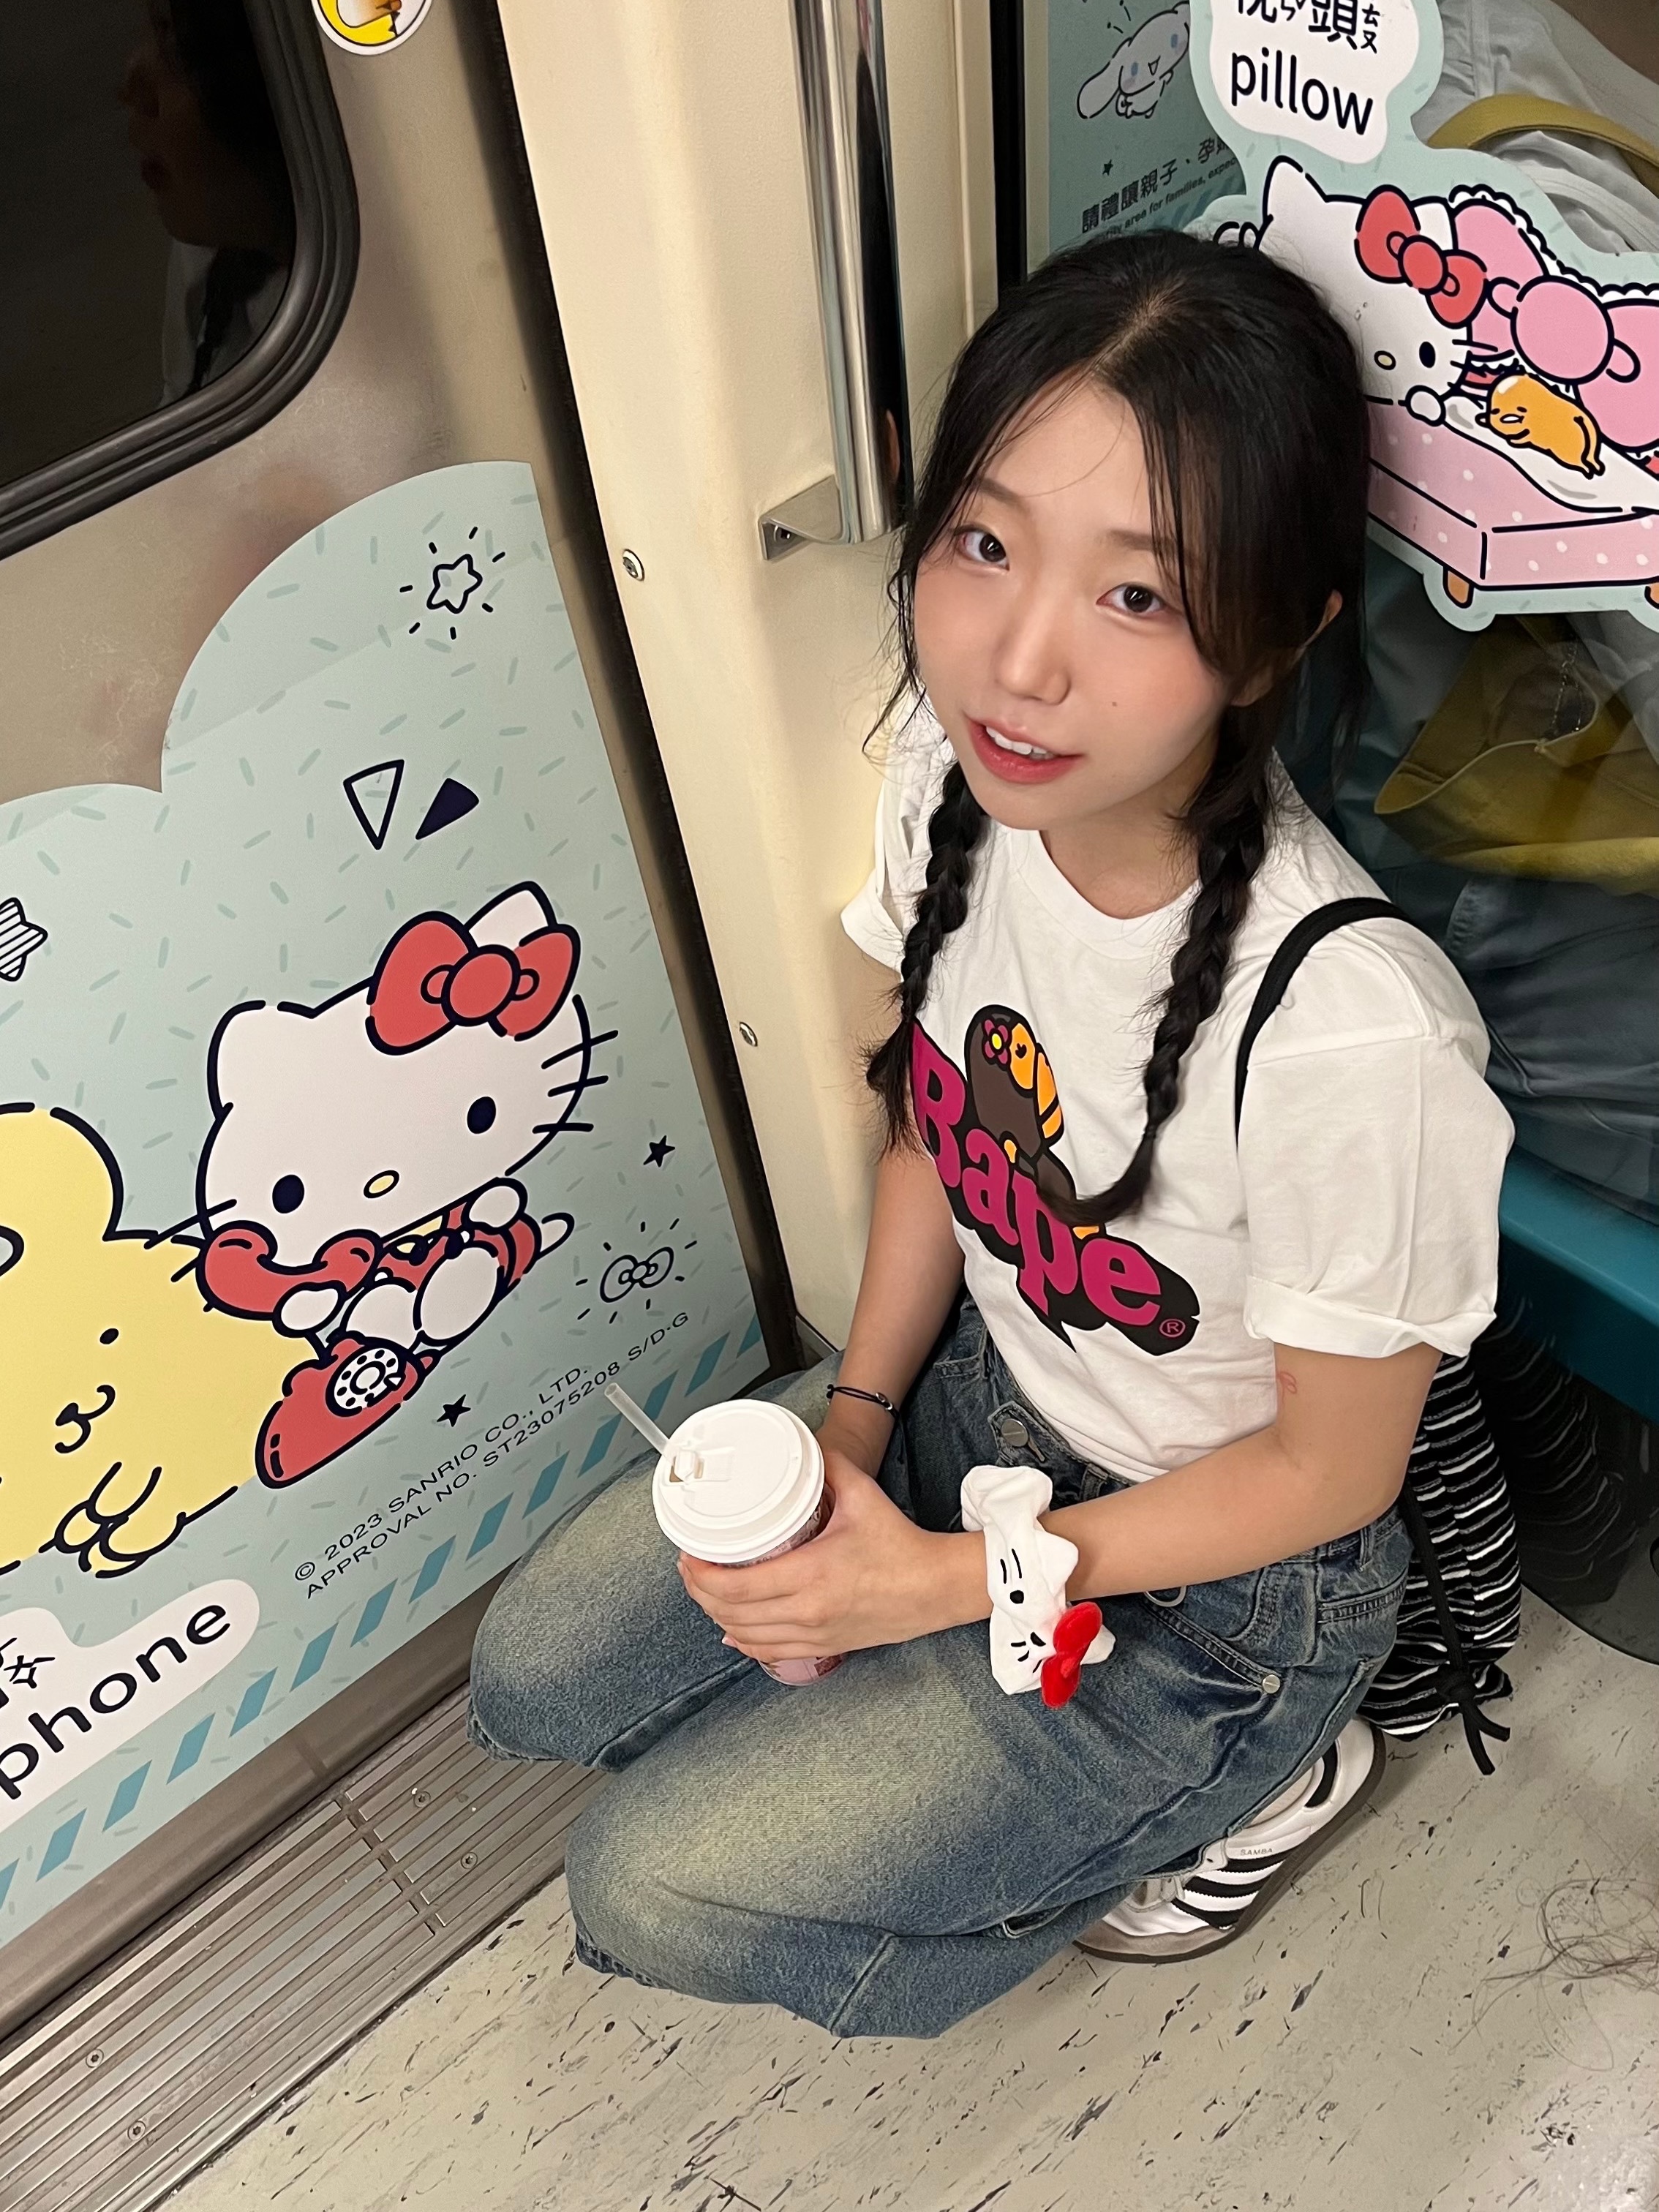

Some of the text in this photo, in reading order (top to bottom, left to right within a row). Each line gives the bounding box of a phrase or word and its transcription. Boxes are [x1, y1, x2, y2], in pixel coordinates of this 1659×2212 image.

[1232, 47, 1373, 135] pillow
[1125, 209, 1146, 228] area
[1149, 198, 1164, 214] for
[1208, 157, 1238, 179] expec
[912, 1019, 1162, 1327] Bape
[307, 1505, 432, 1599] APPROVAL
[435, 1472, 477, 1502] NO.
[483, 1361, 620, 1467] ST23075208
[324, 1513, 383, 1561] 2023
[388, 1444, 478, 1513] SANRIO
[484, 1410, 534, 1442] CO.,
[538, 1367, 588, 1404] LTD.
[0, 1604, 230, 1799] phone
[1240, 1848, 1273, 1856] SAMBA
